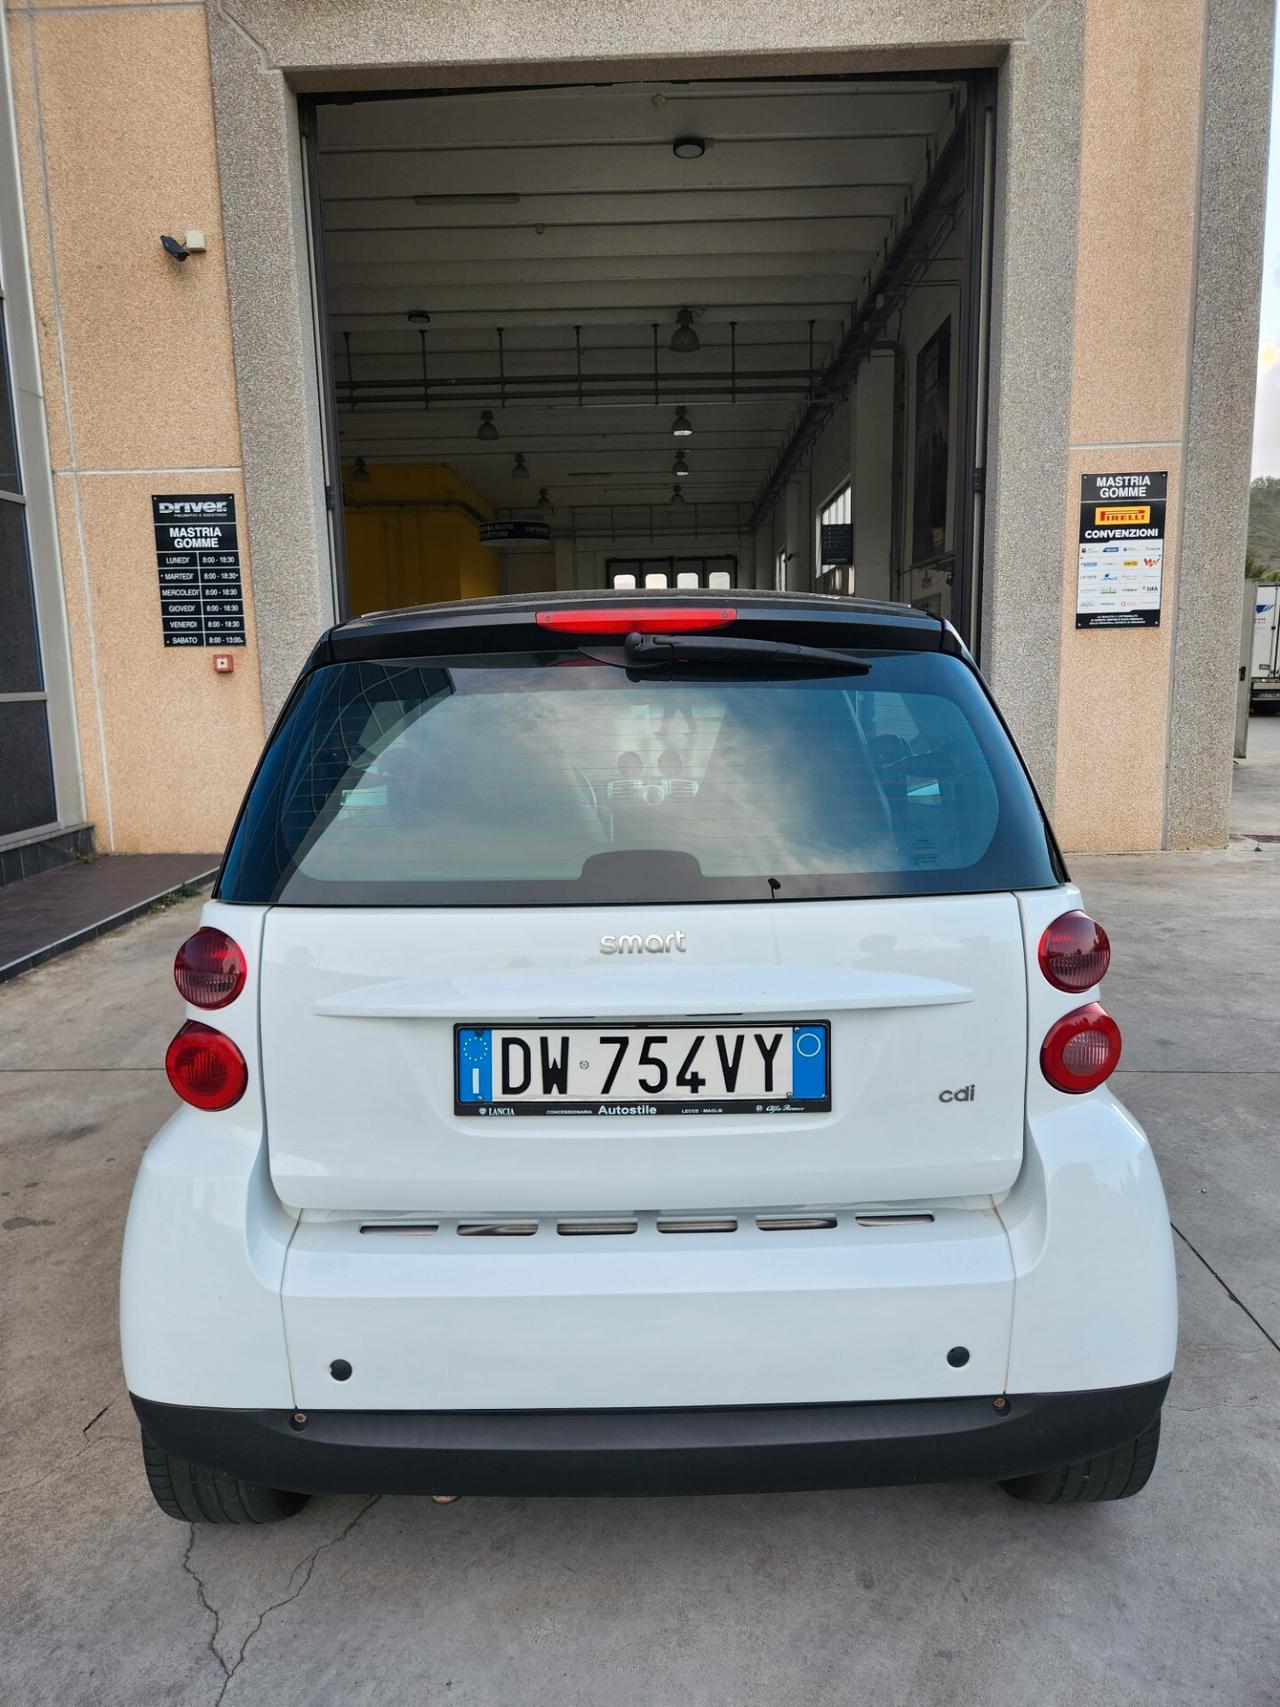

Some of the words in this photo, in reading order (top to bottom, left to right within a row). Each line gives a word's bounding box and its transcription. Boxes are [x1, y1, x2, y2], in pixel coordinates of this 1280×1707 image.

[1096, 476, 1151, 487] MASTRIA
[1100, 487, 1147, 498] GOMME
[1100, 510, 1145, 521] PIRELLI
[169, 527, 222, 537] MASTRIA
[1084, 528, 1159, 539] CONVENZIONI
[174, 538, 219, 548] GOMME
[600, 928, 687, 955] smart
[501, 1037, 569, 1095] DW
[600, 1034, 783, 1094] 754VY
[938, 1084, 976, 1103] cdi
[598, 1105, 657, 1115] Autostile
[765, 1105, 782, 1113] Alfa
